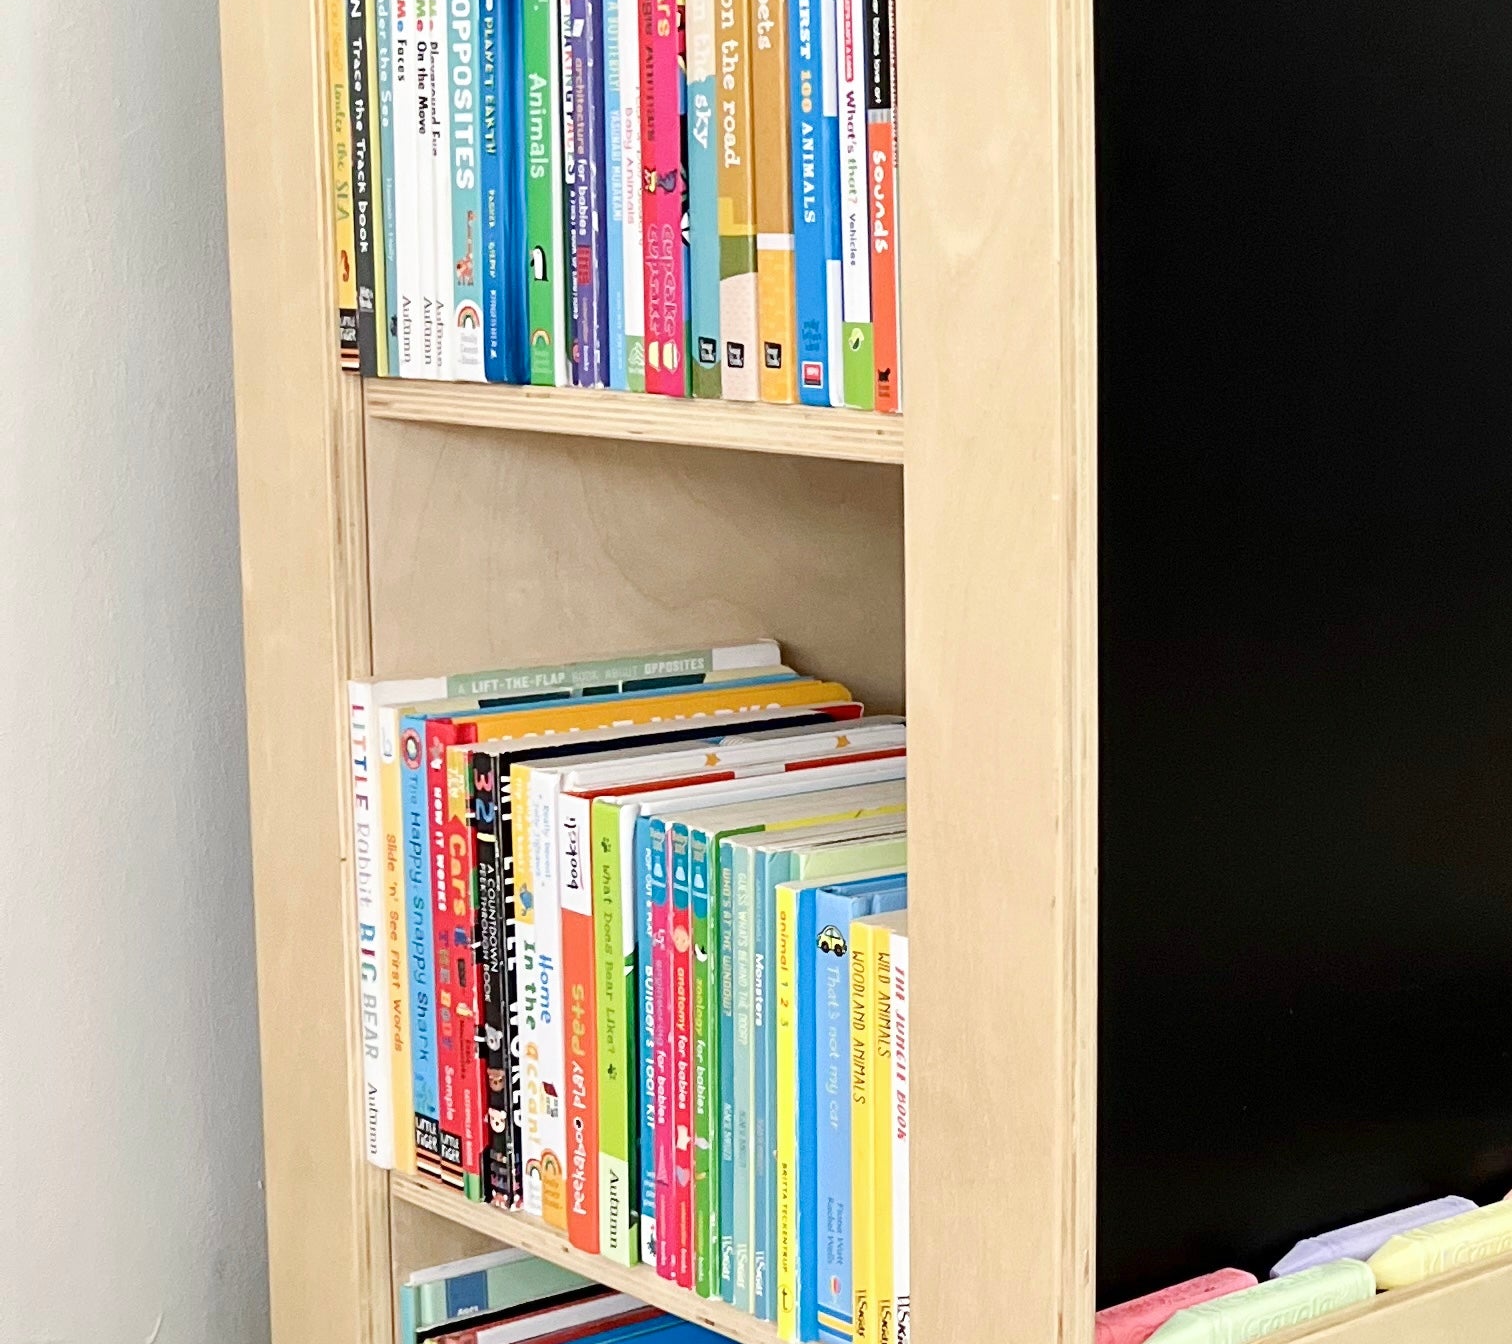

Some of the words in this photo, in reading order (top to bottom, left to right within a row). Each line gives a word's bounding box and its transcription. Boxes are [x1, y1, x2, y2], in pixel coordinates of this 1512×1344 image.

[396, 0, 406, 33] Me
[415, 0, 426, 33] Me
[872, 16, 881, 57] babies
[353, 37, 363, 92] Trace
[379, 47, 391, 82] the
[397, 39, 408, 82] Faces
[417, 41, 428, 62] On
[483, 16, 495, 88] PLANET
[721, 38, 739, 91] the
[873, 58, 882, 85] love
[417, 67, 428, 90] the
[800, 70, 813, 114] 100
[354, 98, 365, 132] the
[381, 89, 392, 128] Sea
[418, 96, 429, 135] Move
[484, 94, 497, 155] EARTH
[528, 72, 549, 179] Animals
[574, 58, 584, 155] architecture
[623, 106, 633, 151] Baby
[845, 90, 858, 154] What's
[723, 100, 741, 168] road
[356, 138, 367, 194] Track
[577, 158, 588, 183] for
[622, 156, 635, 225] Animals
[801, 121, 816, 225] ANIMALS
[847, 157, 858, 205] that?
[358, 200, 368, 253] book
[578, 185, 588, 236] babies
[849, 212, 857, 266] Vehicles
[402, 295, 412, 363] Autumn
[423, 296, 433, 365] Autumn
[351, 704, 369, 811] LITTLE
[474, 767, 494, 792] 3
[409, 774, 419, 805] The
[433, 786, 443, 826] HOW
[475, 798, 496, 824] 2
[355, 822, 370, 909] Rabbit
[434, 831, 445, 849] IT
[435, 854, 448, 913] WORKS
[450, 832, 467, 917] Cars
[486, 863, 495, 875] A
[601, 864, 613, 905] What
[411, 895, 426, 986] Snappy
[487, 877, 500, 973] COUNTDOWN
[602, 912, 614, 955] Does
[359, 922, 377, 984] BIG
[523, 939, 536, 971] In
[878, 951, 891, 985] WILD
[524, 981, 537, 1031] the
[538, 954, 554, 1025] Home
[604, 959, 615, 1001] Bear
[676, 966, 686, 1031] anatomy
[755, 953, 765, 1027] Monsters
[825, 965, 841, 1020] That's
[852, 950, 867, 1031] WOODLAND
[894, 965, 906, 1002] THE
[363, 993, 380, 1060] BEAR
[417, 990, 431, 1062] Shark
[604, 1007, 616, 1055] Like?
[677, 1034, 689, 1059] for
[827, 1025, 840, 1060] not
[877, 992, 892, 1058] ANIMALS
[895, 1009, 907, 1084] JUNGLE
[677, 1060, 689, 1110] babies
[825, 1065, 840, 1095] my
[852, 1038, 867, 1106] ANIMALS
[367, 1081, 379, 1155] Autumn
[828, 1101, 840, 1131] car
[896, 1088, 908, 1141] BOOK
[609, 1168, 620, 1250] Autumn
